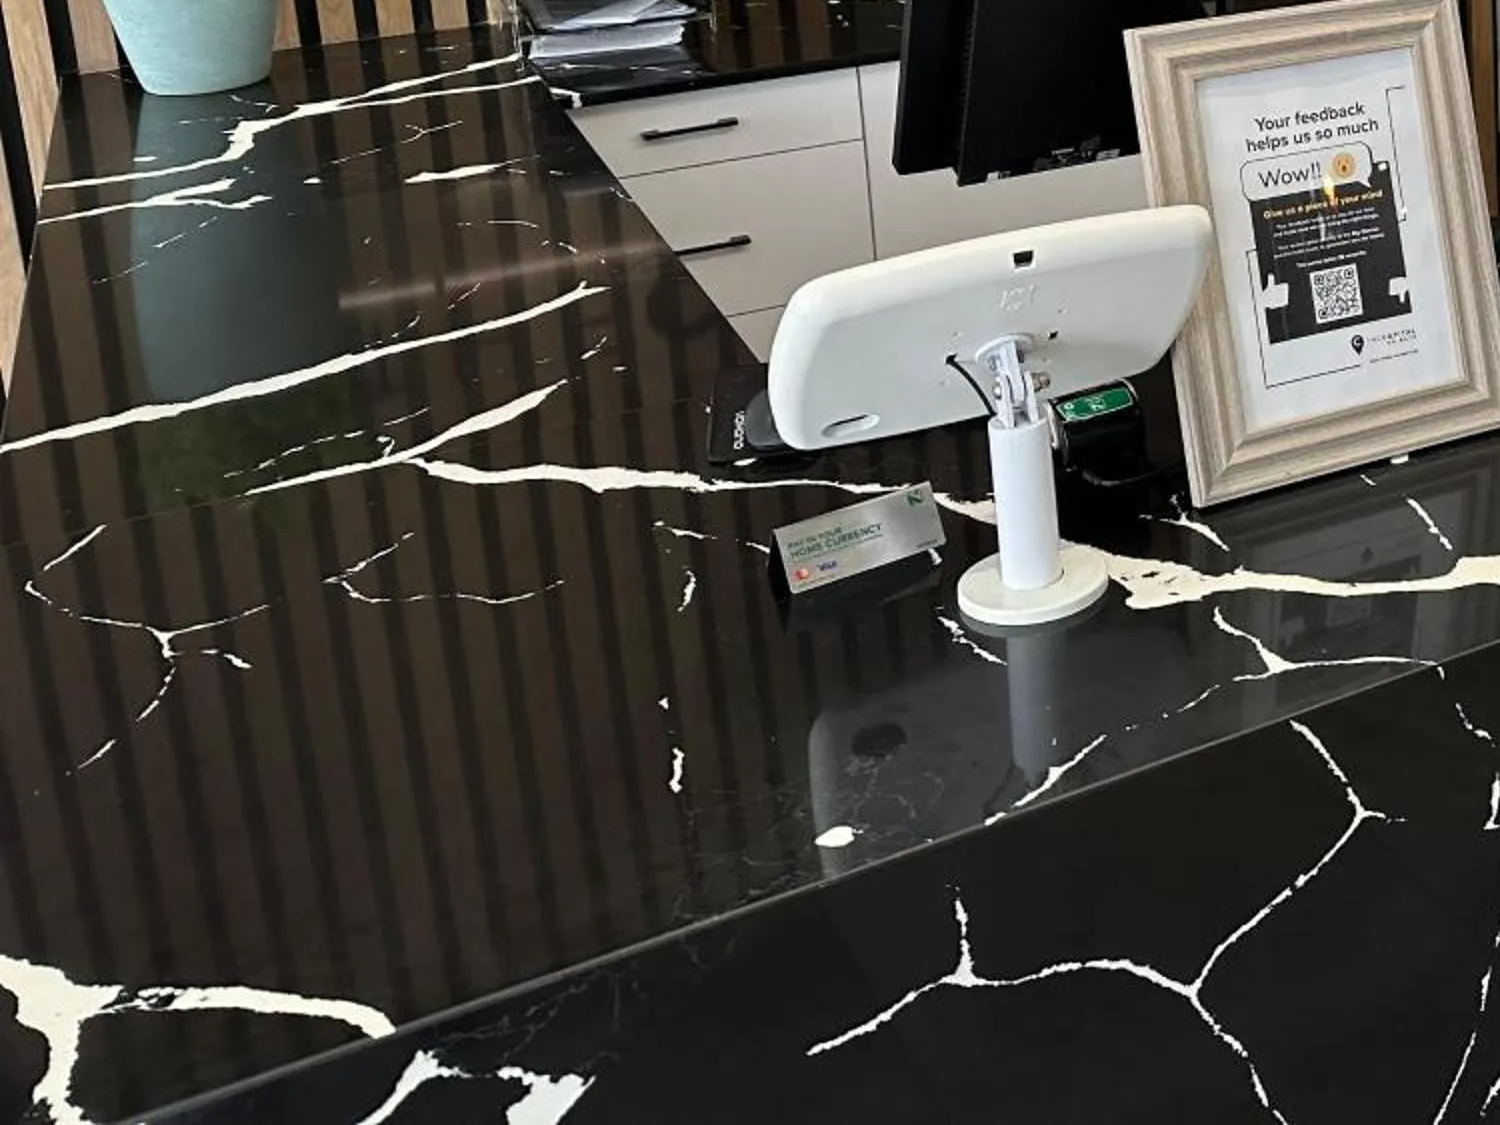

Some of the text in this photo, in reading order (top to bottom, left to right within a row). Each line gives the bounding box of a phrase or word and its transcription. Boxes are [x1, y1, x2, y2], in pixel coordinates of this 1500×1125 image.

[1254, 101, 1366, 132] Your feedback
[1246, 119, 1379, 152] helps us so much
[1258, 161, 1322, 188] Wow!!
[824, 523, 883, 548] CURRENCY
